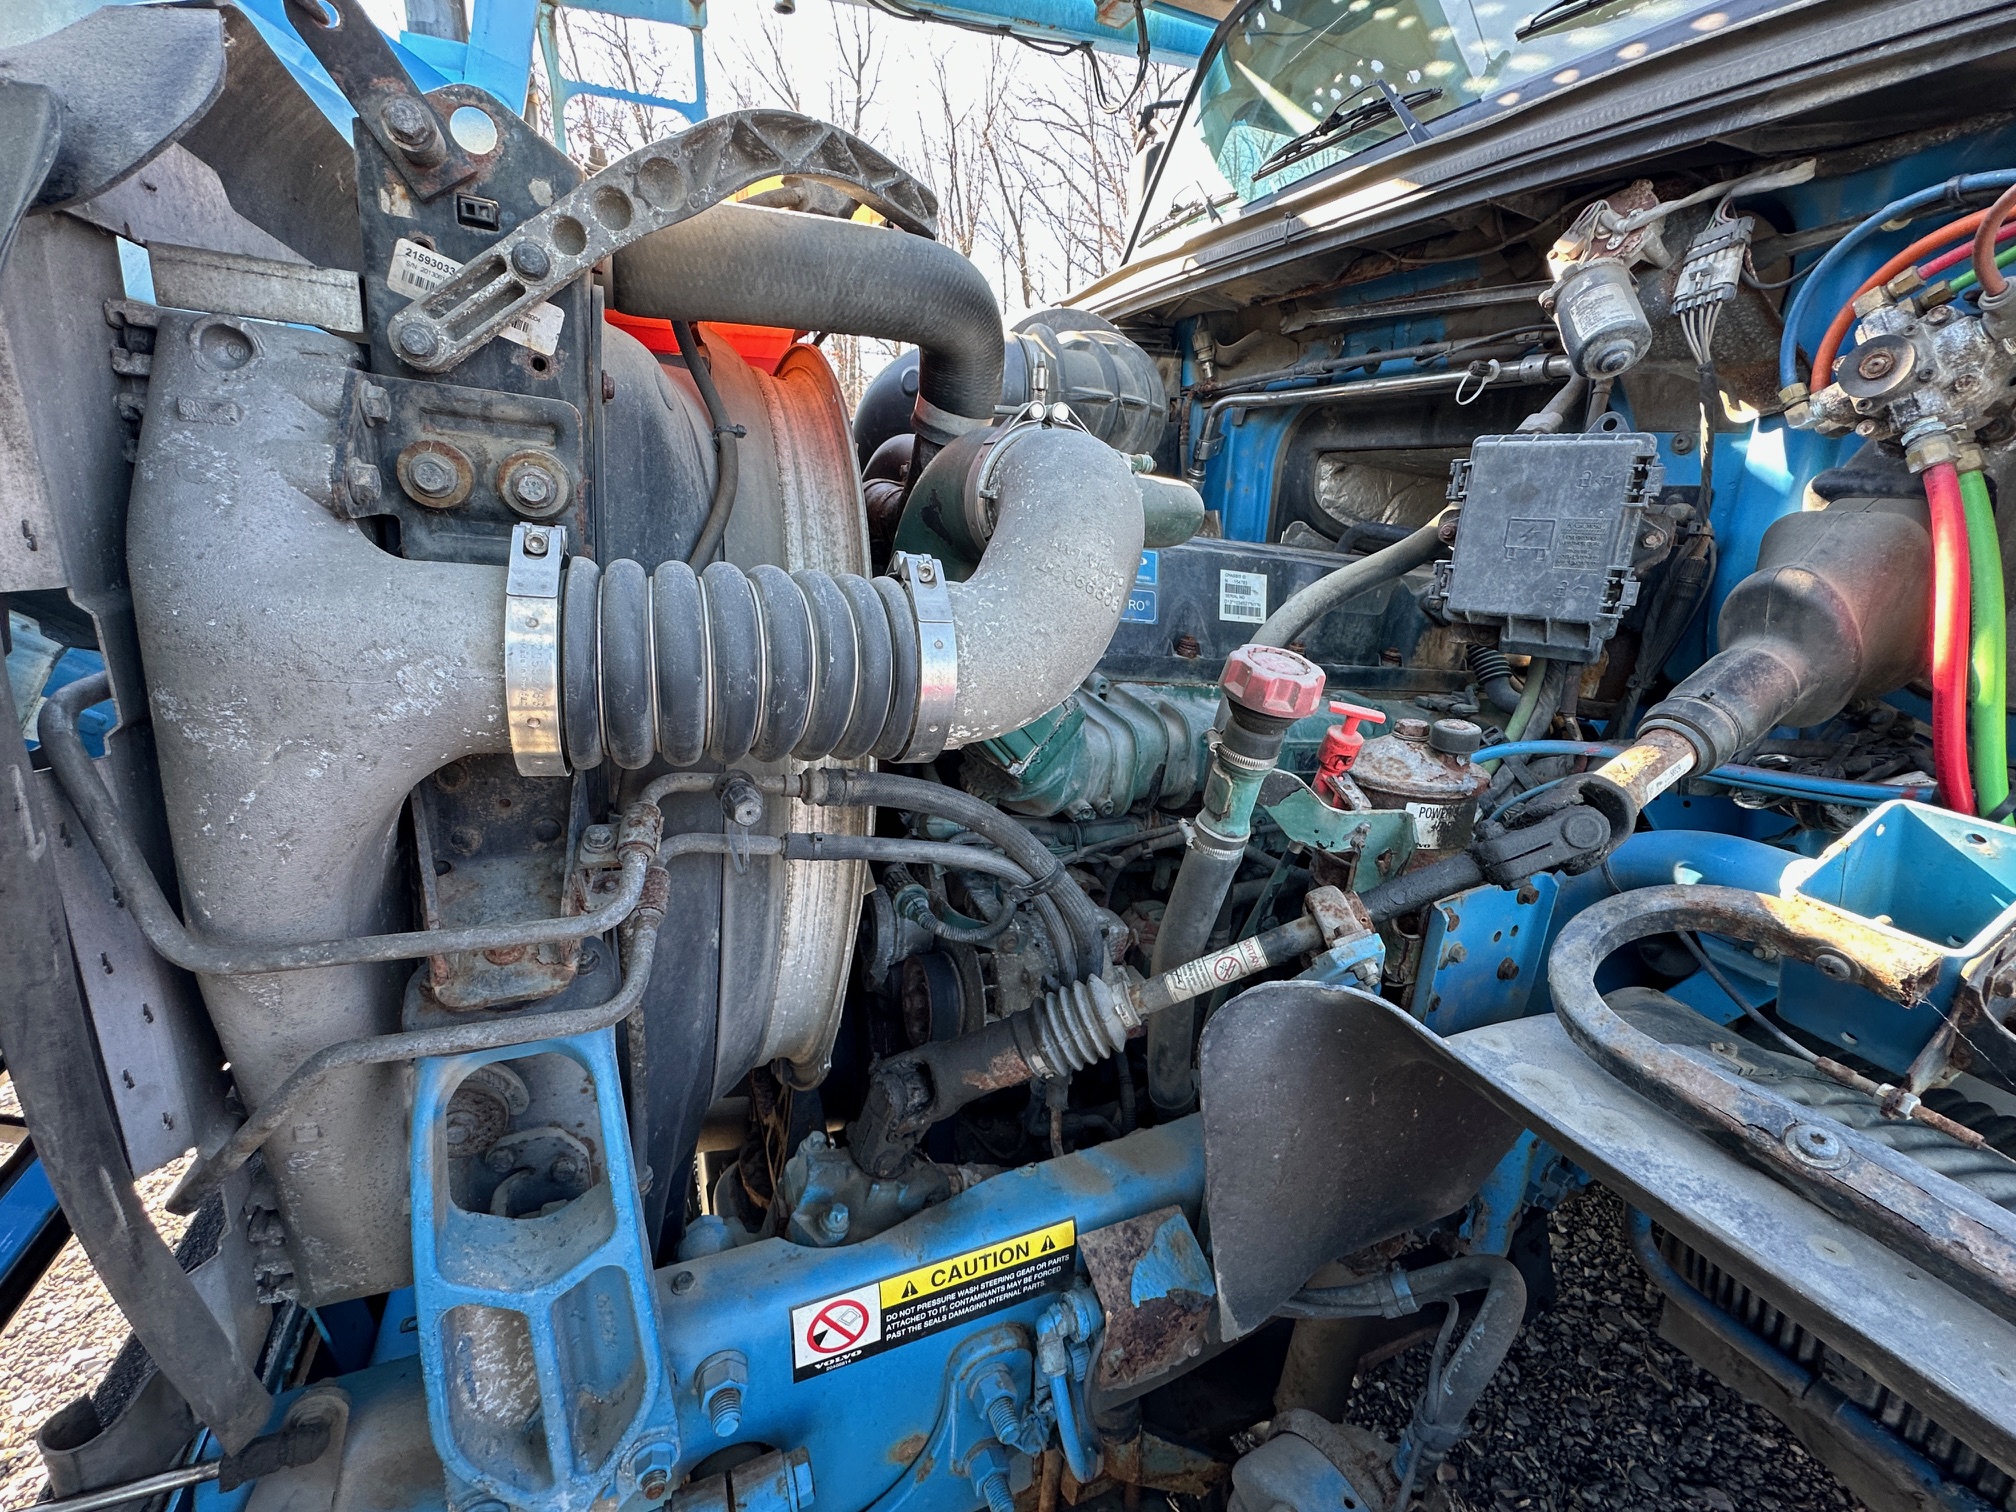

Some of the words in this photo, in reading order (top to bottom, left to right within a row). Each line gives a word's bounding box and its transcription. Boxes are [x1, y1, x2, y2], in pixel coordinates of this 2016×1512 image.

[405, 248, 456, 275] 21593033
[886, 1312, 898, 1322] DO
[899, 1306, 916, 1317] NOT
[916, 1292, 956, 1311] PRESSURE
[957, 1284, 980, 1298] WASH
[980, 1273, 1015, 1290] STEERING
[1016, 1265, 1035, 1278] GEAR
[1036, 1261, 1047, 1271] OR
[1047, 1254, 1070, 1267] PARTS
[931, 1241, 1030, 1287] CAUTION
[886, 1312, 927, 1332] ATTACHED
[927, 1308, 938, 1317] TO
[949, 1285, 1006, 1310] CONTAMINANTS
[1006, 1278, 1023, 1290] MAY
[1023, 1275, 1033, 1284] BE
[1033, 1265, 1062, 1281] FORCED
[886, 1328, 906, 1341] PAST
[907, 1322, 923, 1333] THE
[923, 1314, 947, 1328] SEALS
[948, 1301, 987, 1319] DAMAGING
[988, 1289, 1022, 1305] INTERNAL
[1022, 1280, 1047, 1293] PARTS.
[814, 1349, 862, 1369] VOLVO
